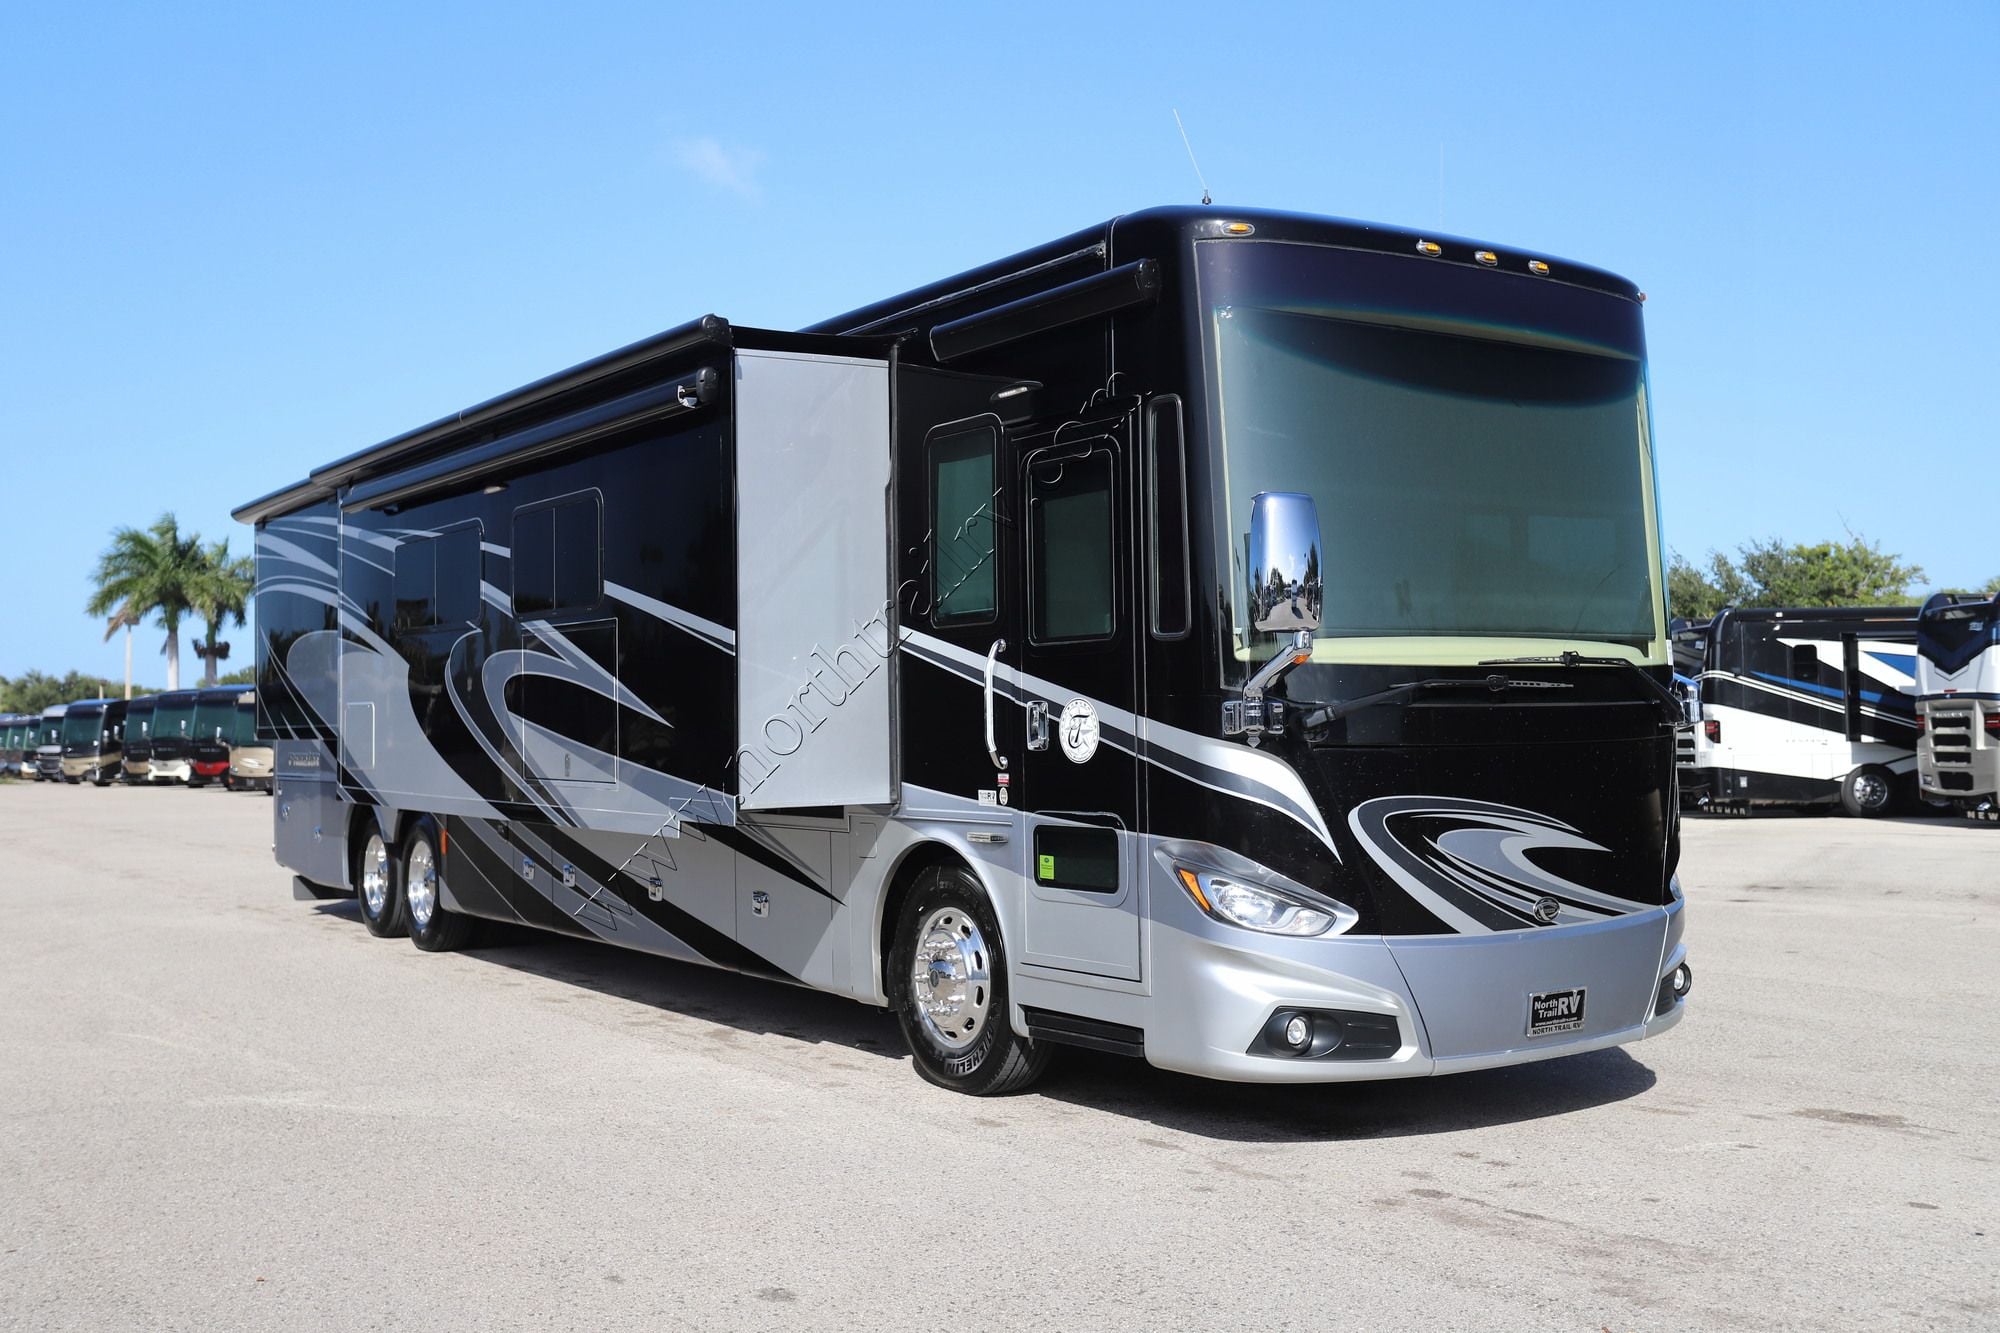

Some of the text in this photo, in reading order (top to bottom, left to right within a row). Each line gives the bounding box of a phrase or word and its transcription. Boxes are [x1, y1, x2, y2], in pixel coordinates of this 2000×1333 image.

[1534, 999, 1558, 1010] North
[1558, 995, 1581, 1016] RV
[1538, 1007, 1558, 1018] Trail
[1532, 1026, 1553, 1035] NORTH
[1554, 1024, 1572, 1033] TRAIL
